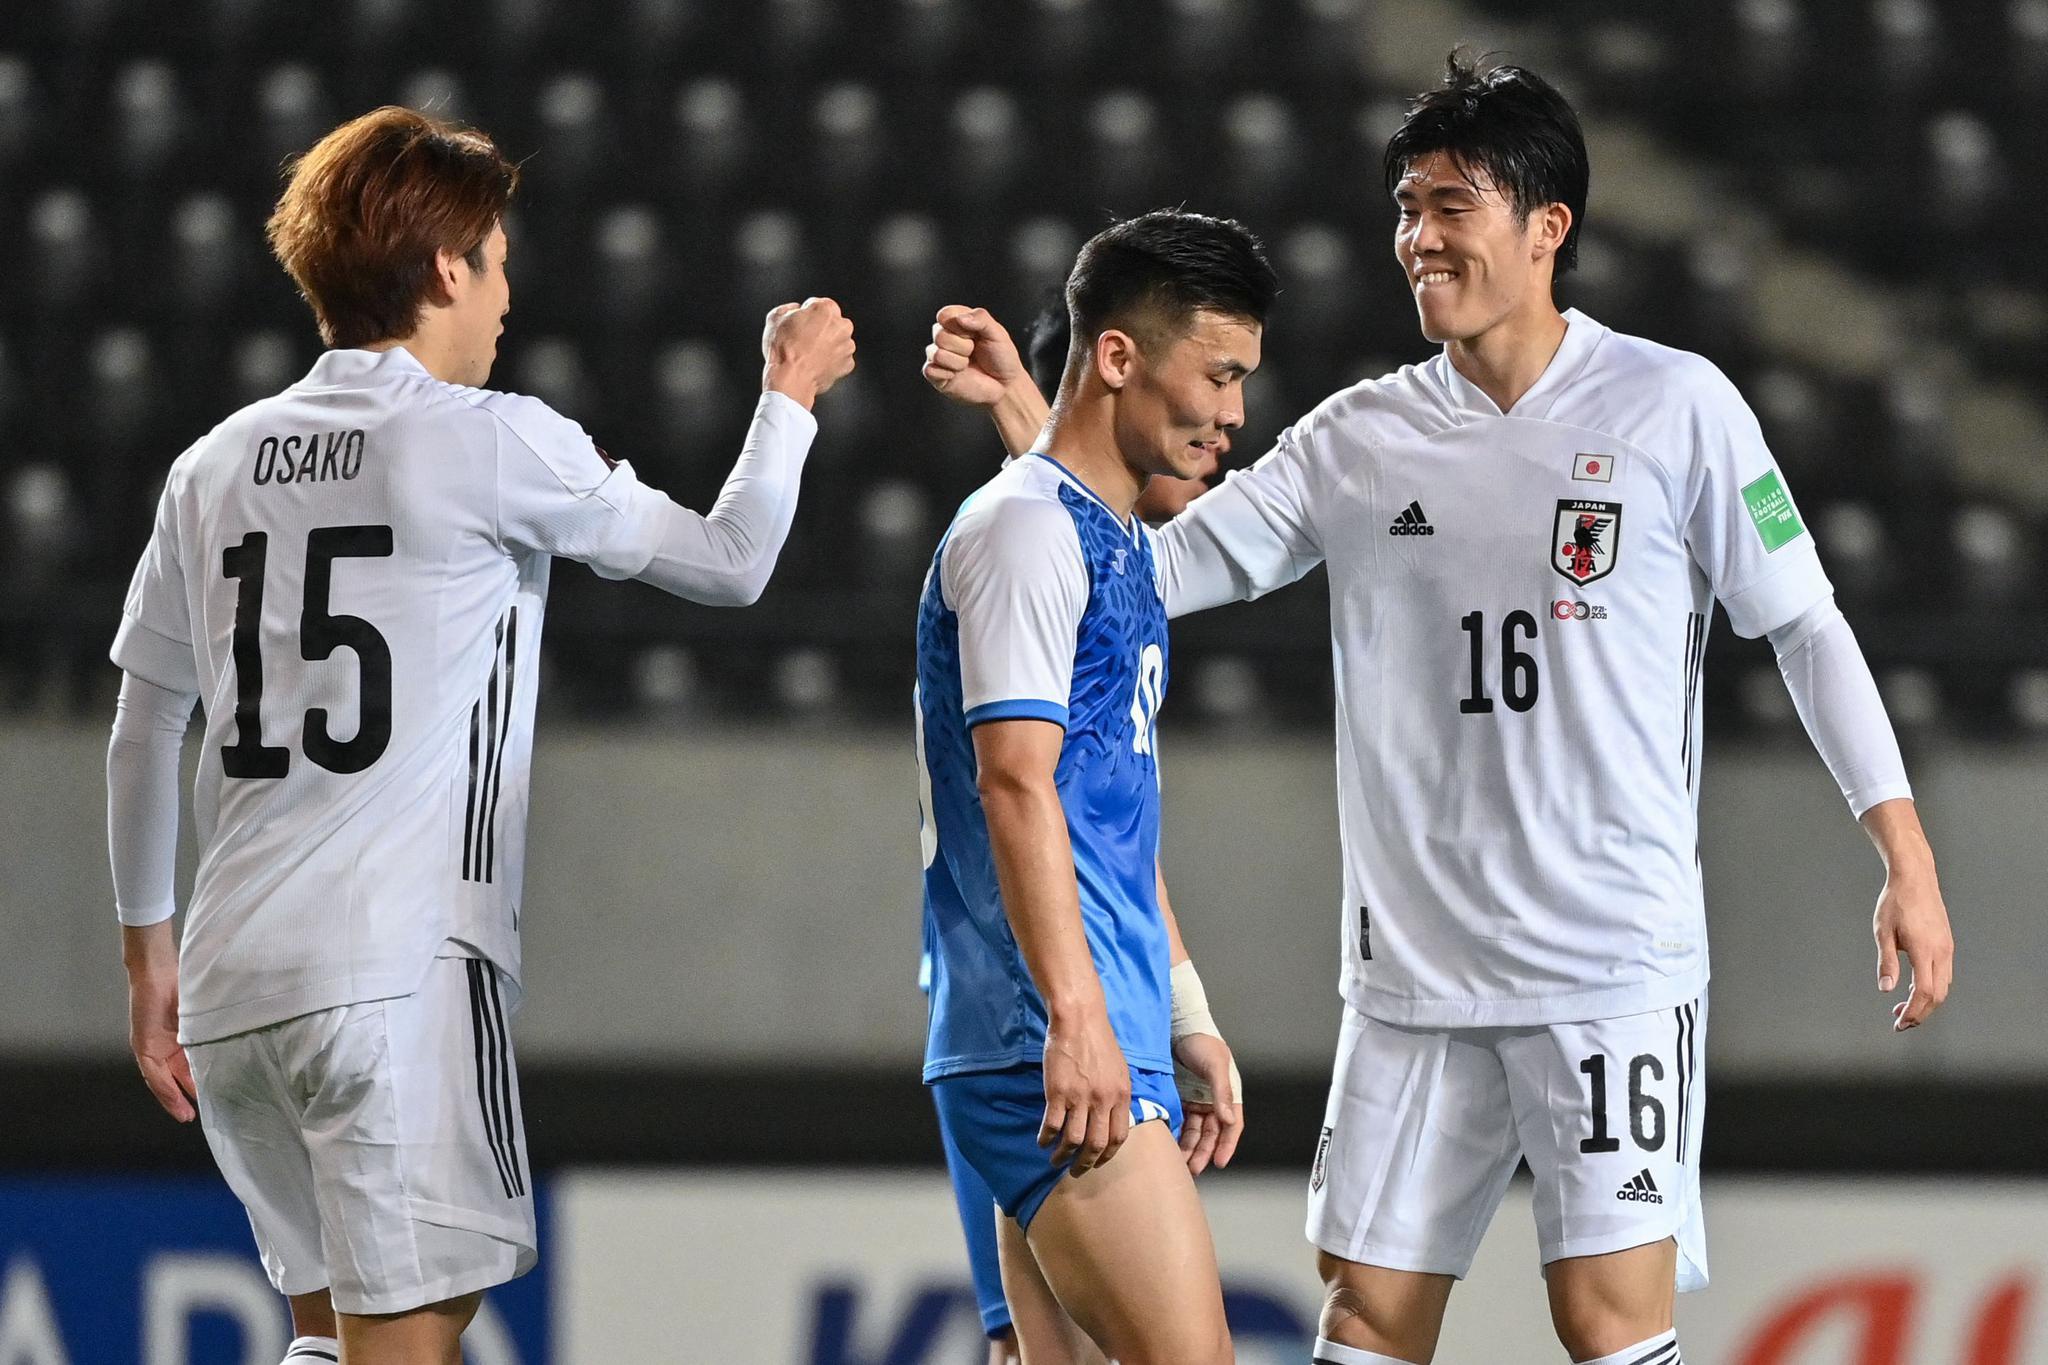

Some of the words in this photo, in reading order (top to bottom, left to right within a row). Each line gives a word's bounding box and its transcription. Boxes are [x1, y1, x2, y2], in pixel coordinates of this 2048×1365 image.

[253, 429, 365, 486] OSAKO
[1571, 501, 1607, 512] JAPAN
[1750, 487, 1782, 512] LIVING
[1753, 496, 1786, 520] FOOTBALL
[1777, 508, 1793, 525] FIFA
[1389, 523, 1434, 536] adidas
[1566, 557, 1598, 573] JFA
[1550, 600, 1591, 621] 100
[1590, 612, 1608, 620] 2021
[221, 525, 394, 779] 15
[1459, 609, 1540, 714] 16
[1578, 1052, 1667, 1154] 16
[1616, 1189, 1664, 1205] adidas
